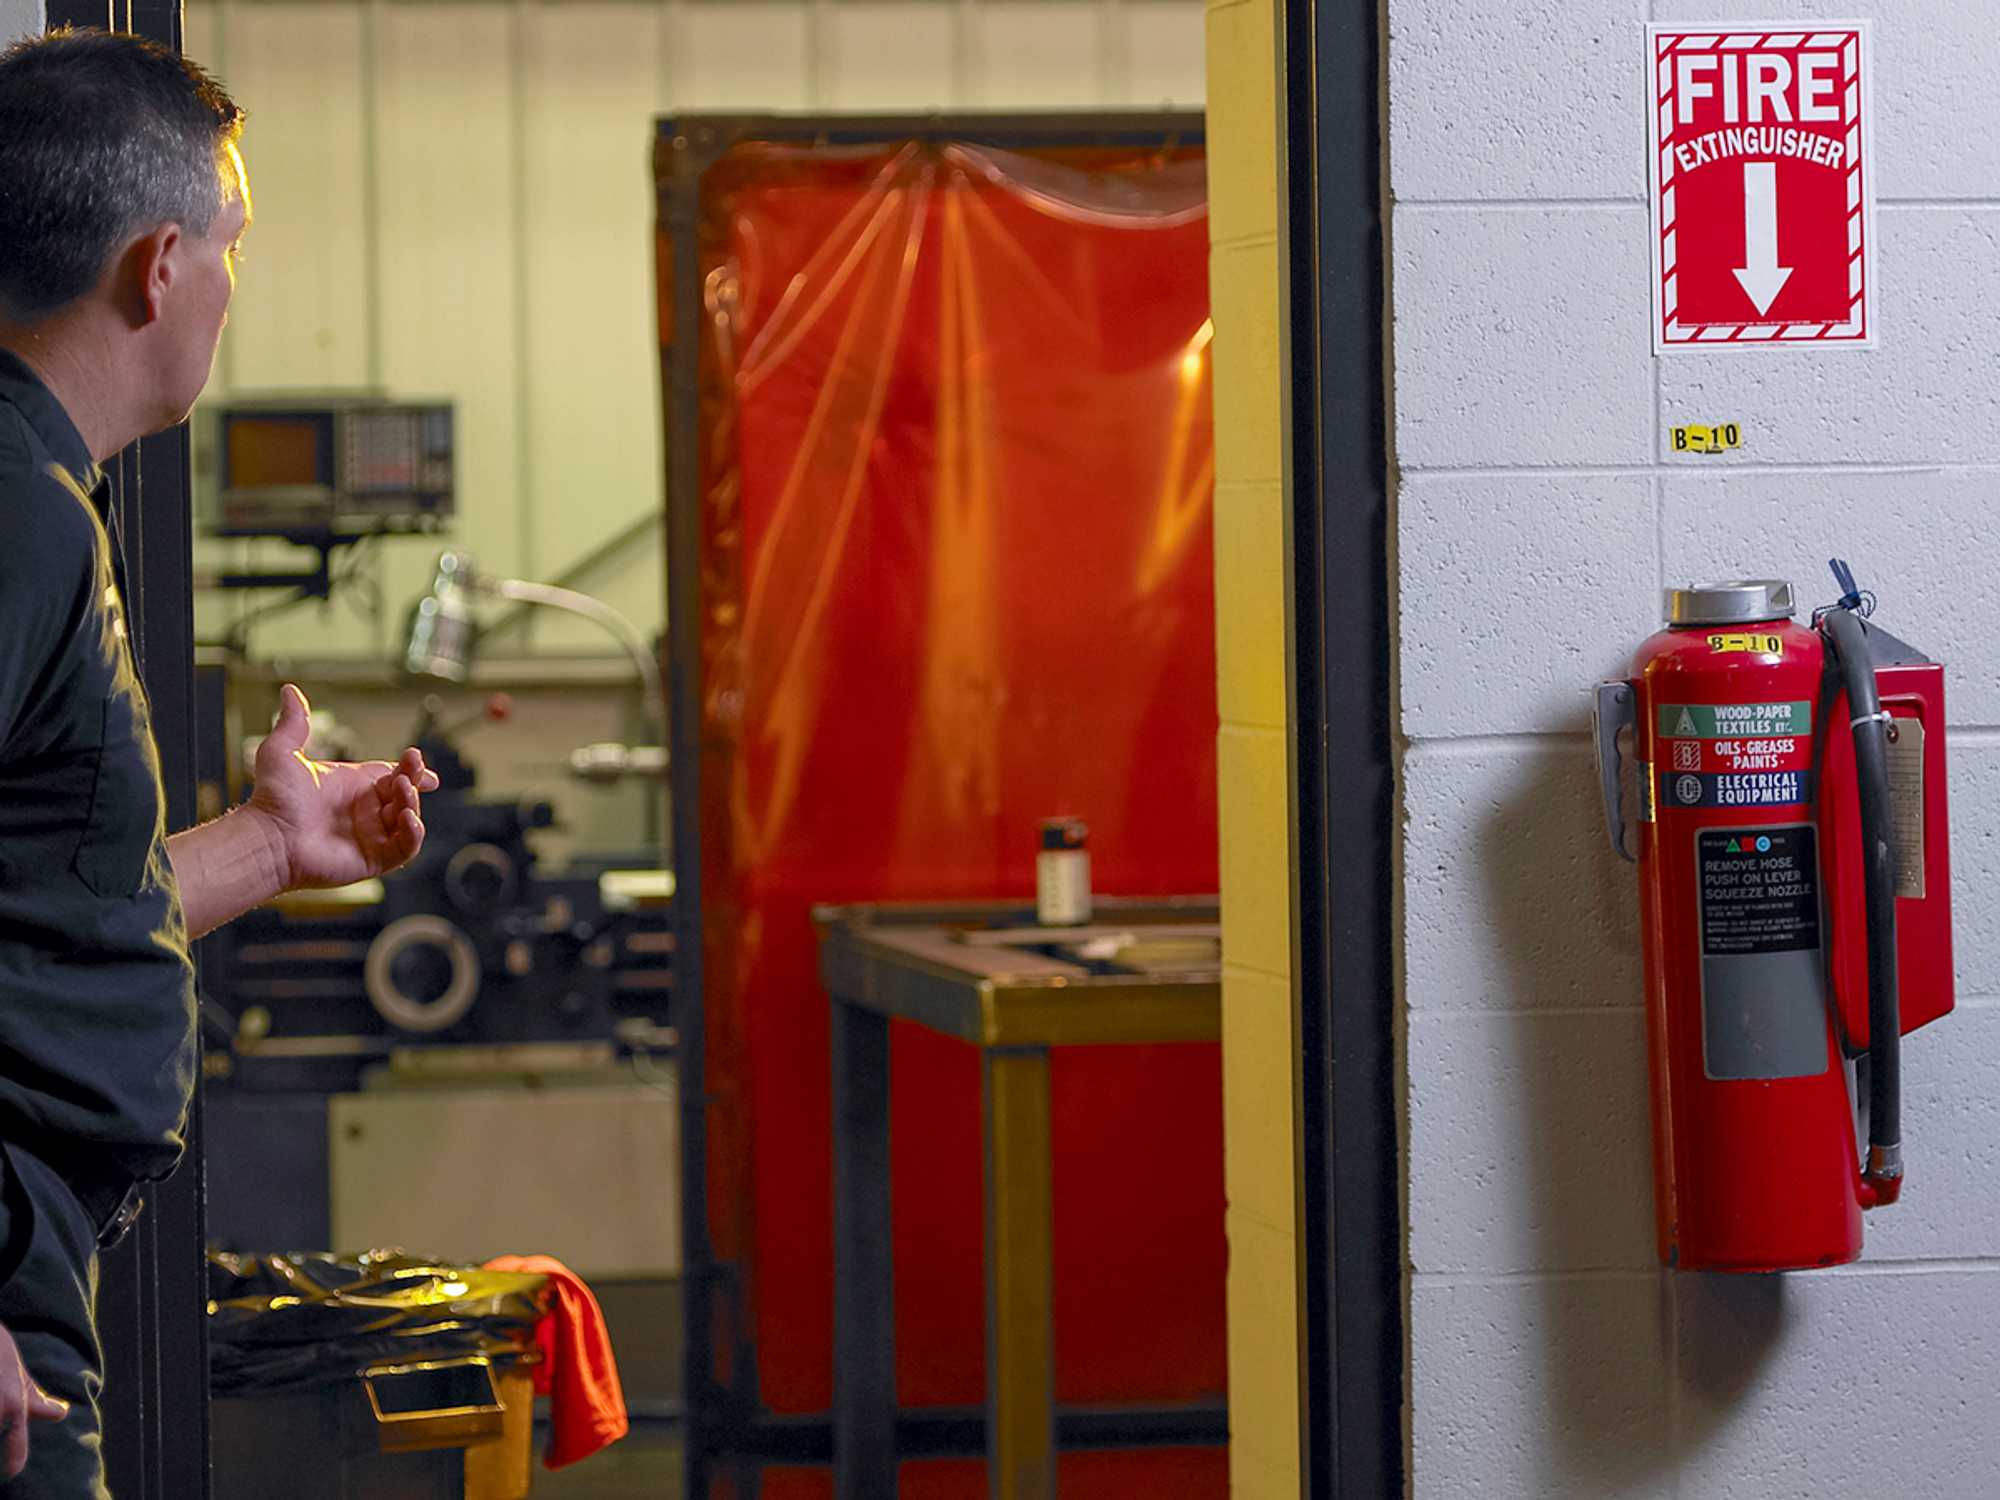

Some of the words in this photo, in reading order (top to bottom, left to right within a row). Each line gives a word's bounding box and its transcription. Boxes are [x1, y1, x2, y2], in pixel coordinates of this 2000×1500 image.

[1677, 52, 1840, 124] FIRE
[1675, 126, 1844, 172] EXTINGUISHER
[1674, 423, 1738, 450] B-10
[1711, 635, 1780, 653] B-10
[1714, 704, 1792, 719] WOOD-PAPER
[1715, 720, 1771, 734] TEXTILES
[1717, 773, 1798, 789] ELECTRICAL
[1717, 787, 1798, 804] EQUIPMENT
[1705, 860, 1757, 873] REMOVE
[1760, 857, 1793, 870] HOSE
[1705, 873, 1739, 886] PUSH
[1742, 872, 1761, 885] ON
[1765, 870, 1801, 883] LEVER
[1705, 887, 1765, 900] SQUEEZE
[1768, 883, 1812, 898] NOZZLE
